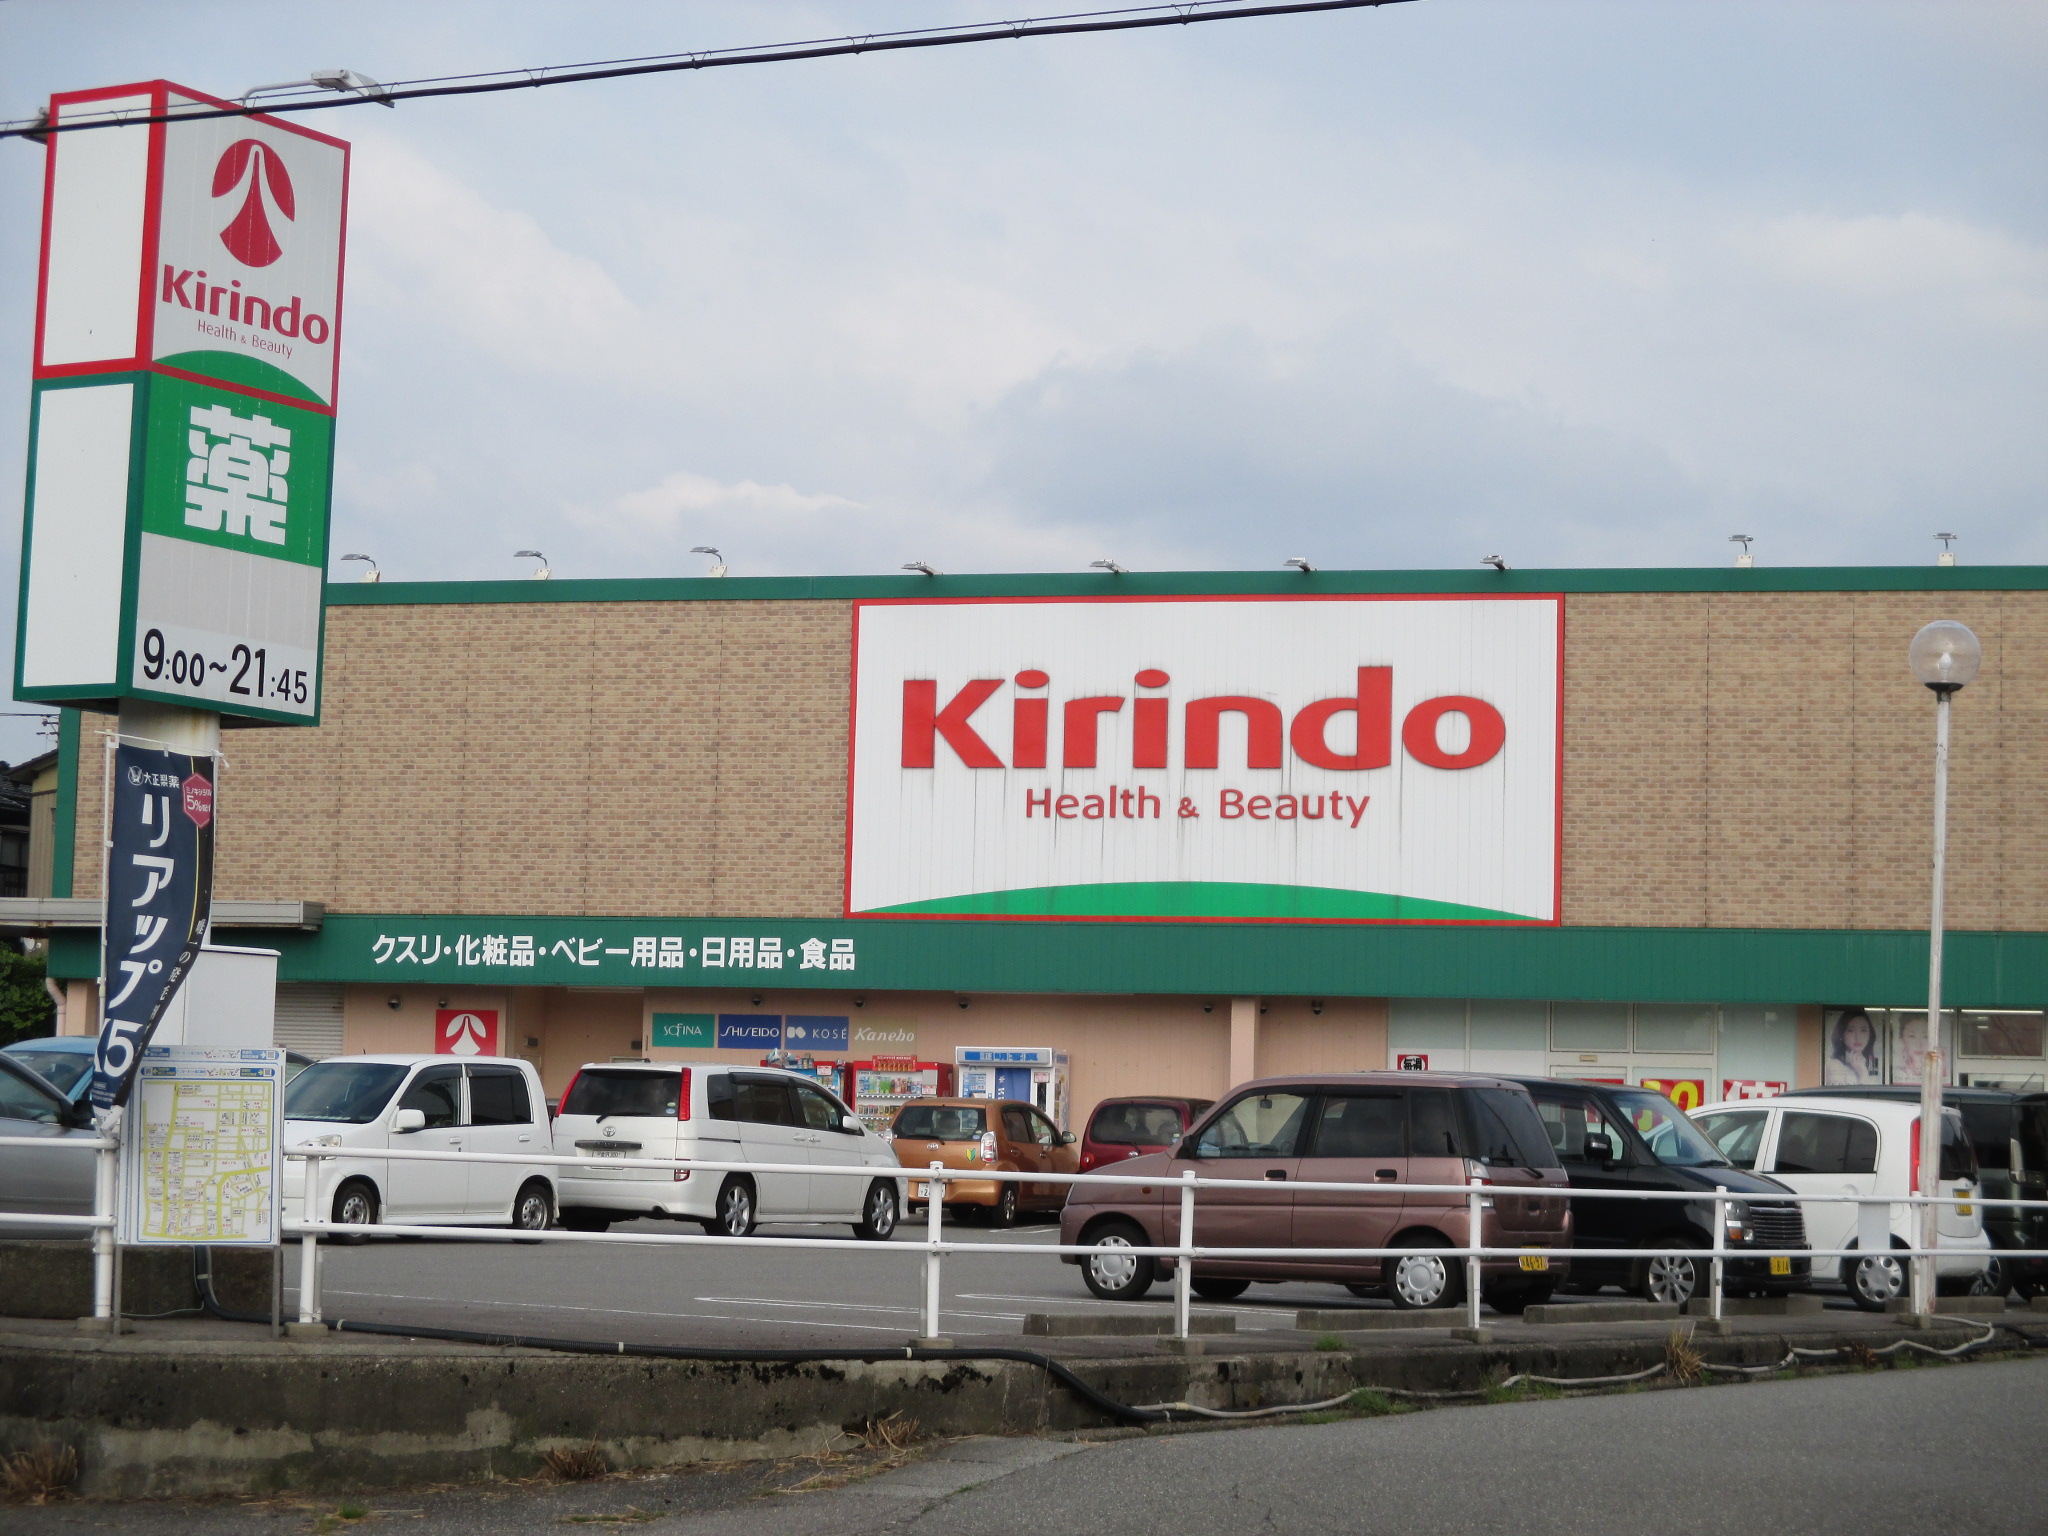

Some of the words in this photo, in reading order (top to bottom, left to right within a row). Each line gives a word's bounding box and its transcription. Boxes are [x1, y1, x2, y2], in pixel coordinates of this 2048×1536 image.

[162, 264, 330, 345] Kirindo
[197, 318, 237, 342] Health
[240, 334, 247, 344] &
[251, 333, 293, 360] Beauty
[184, 403, 291, 546] 薬
[900, 665, 1506, 771] Kirindo
[1025, 785, 1161, 820] Health
[1176, 796, 1200, 819] &
[1219, 788, 1371, 829] Beauty
[720, 1024, 780, 1038] SHISEIDO
[812, 1027, 848, 1040] KOSÉ
[854, 1027, 915, 1043] Kanebo
